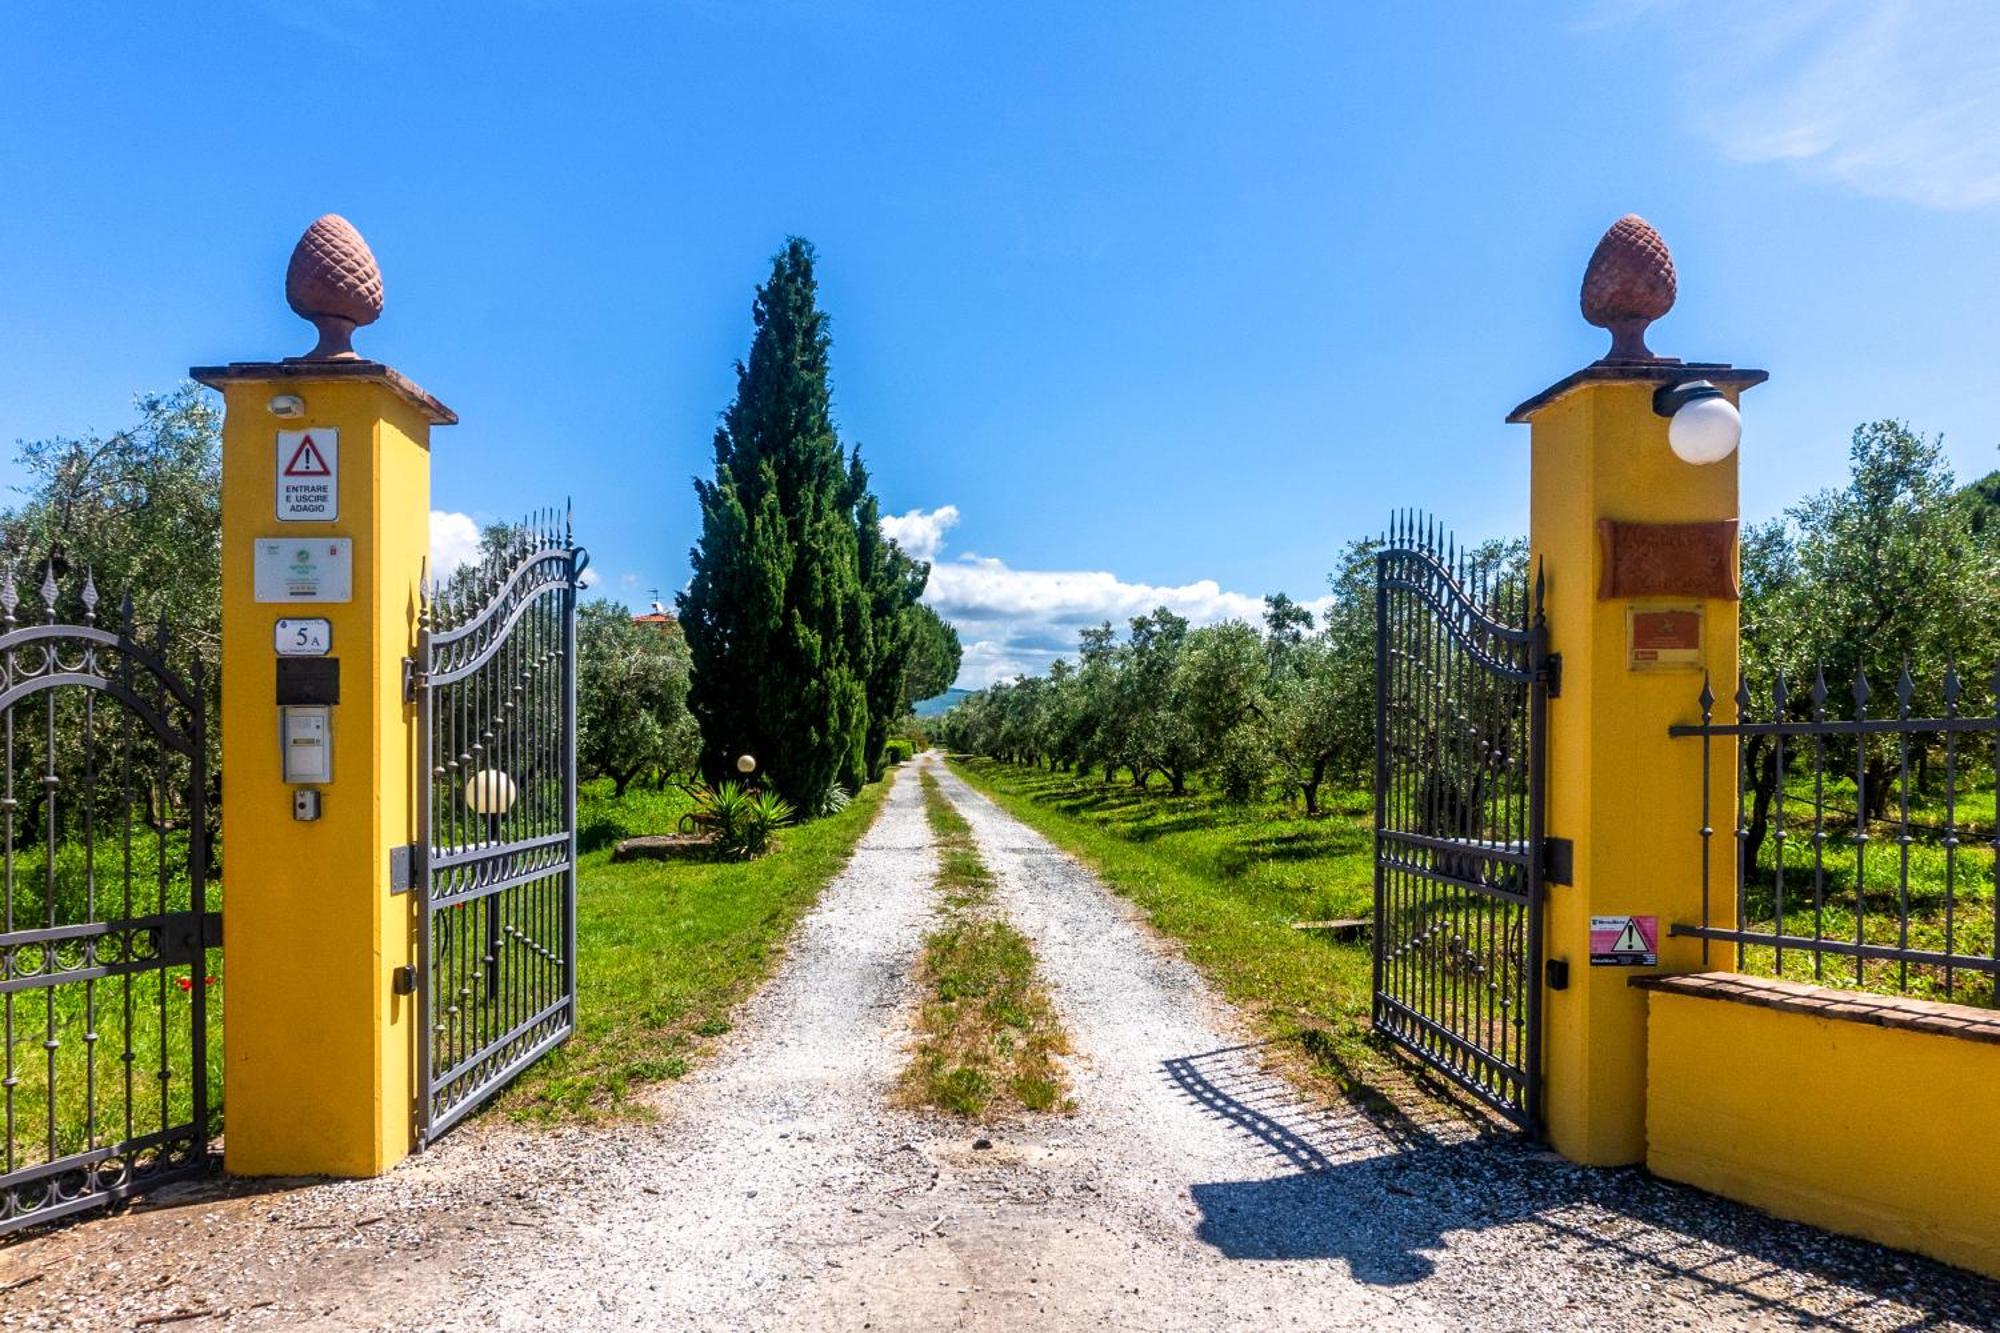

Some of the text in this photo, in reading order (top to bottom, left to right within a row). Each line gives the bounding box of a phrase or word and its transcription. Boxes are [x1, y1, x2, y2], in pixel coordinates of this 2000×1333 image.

[286, 485, 329, 493] ENTRARE
[286, 495, 329, 503] E USCIRE
[289, 504, 325, 513] ADAGIO
